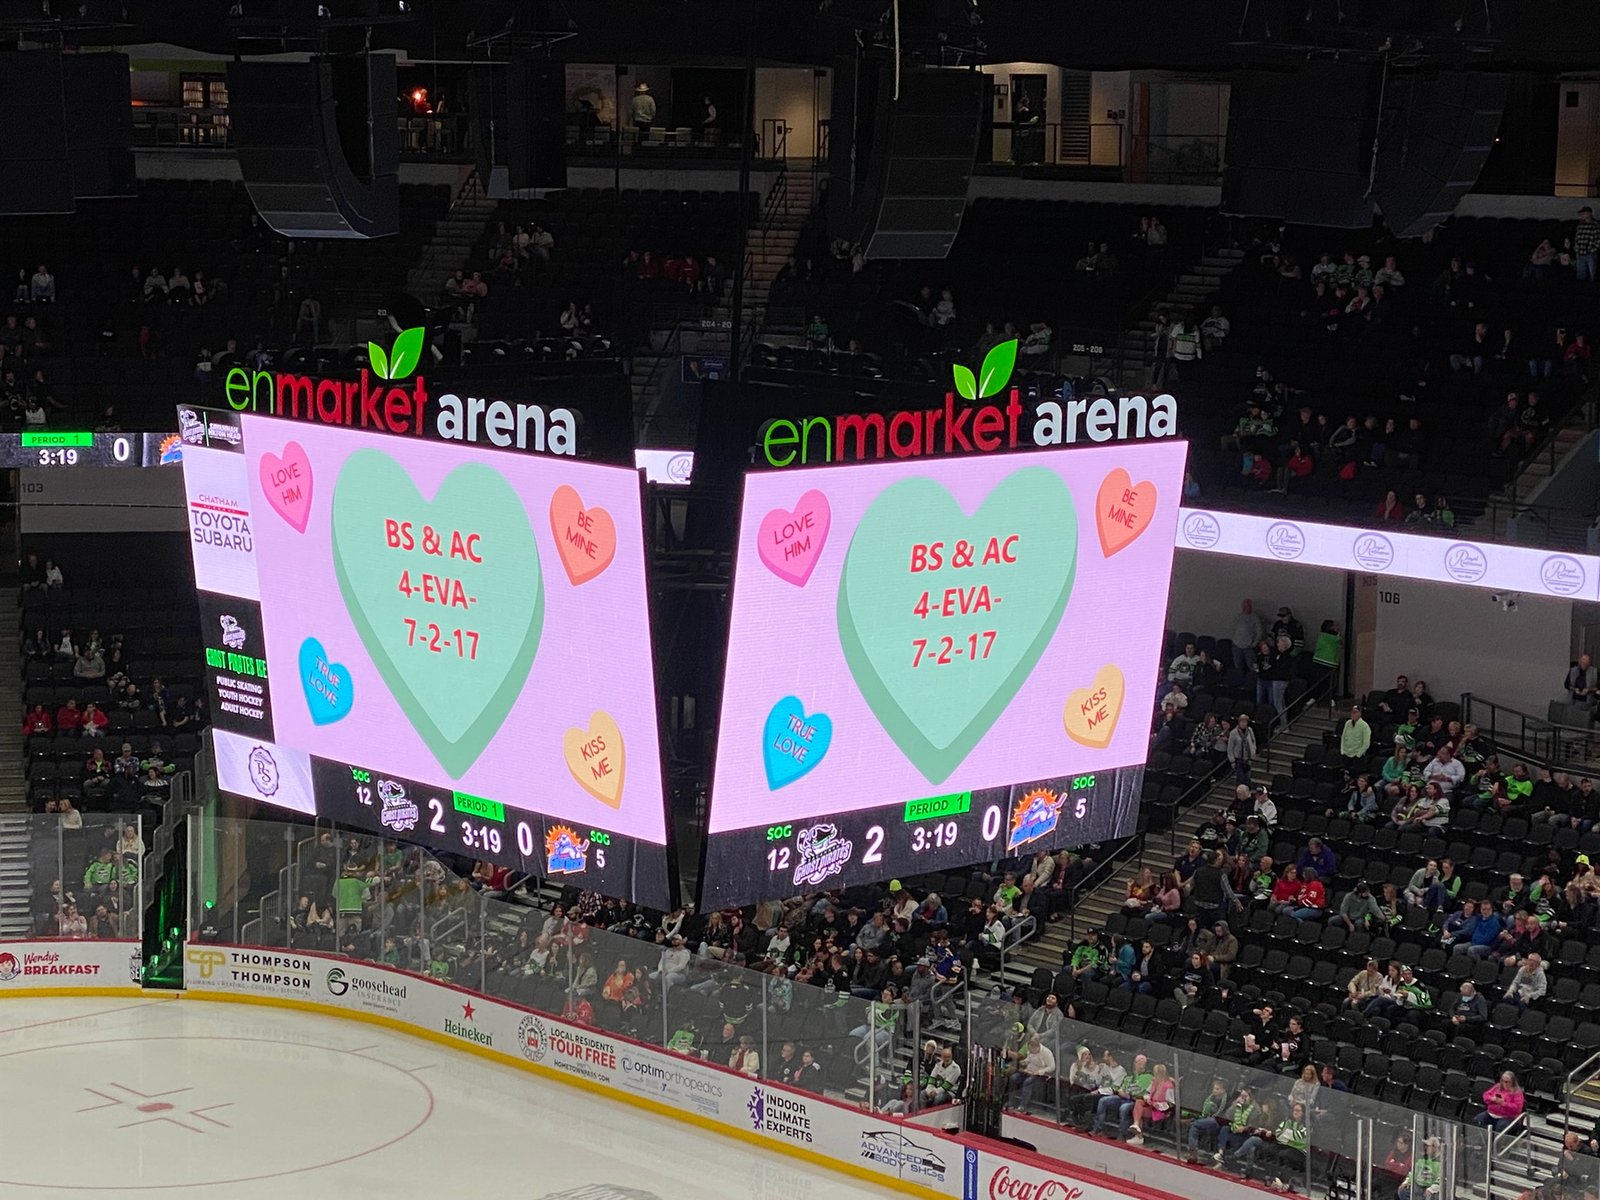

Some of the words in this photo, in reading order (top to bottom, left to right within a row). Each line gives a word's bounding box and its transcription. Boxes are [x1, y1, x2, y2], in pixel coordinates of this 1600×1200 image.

[225, 367, 428, 436] enmarket
[436, 393, 577, 456] arena
[763, 385, 1023, 467] enmarket
[1032, 393, 1179, 447] arena
[32, 436, 66, 444] PERIOD
[74, 435, 80, 444] 1
[113, 438, 130, 461] 0
[38, 449, 78, 465] 3:19
[271, 462, 301, 487] LOVE
[22, 483, 44, 493] 103
[281, 485, 302, 505] HIM
[1121, 488, 1138, 506] BE
[199, 494, 239, 509] CHATHAM
[191, 509, 251, 535] TOYOTA
[577, 511, 594, 533] BE
[773, 512, 815, 545] LOVE
[1107, 505, 1138, 529] MINE
[193, 527, 253, 553] SUBARU
[385, 519, 415, 551] BS
[422, 525, 443, 556] &
[450, 531, 482, 563] AC
[566, 526, 598, 559] MINE
[784, 536, 812, 562] HIM
[910, 541, 944, 573] BS
[951, 540, 974, 568] &
[982, 534, 1020, 566] AC
[398, 570, 477, 610] 4-EVA-
[1379, 591, 1400, 604] 106
[913, 585, 1003, 620] 4-EVA-
[404, 618, 479, 660] 7-2-17
[911, 631, 997, 668] 7-2-17
[216, 675, 236, 688] PUBLIC
[236, 681, 263, 694] SKATING
[316, 655, 341, 691] TRUE
[218, 688, 238, 701] YOUTH
[238, 694, 263, 707] HOCKEY
[308, 671, 338, 708] LOVE
[1080, 686, 1107, 716] KISS
[220, 701, 239, 714] ADULT
[239, 706, 264, 720] HOCKEY
[1087, 704, 1110, 730] ME
[787, 713, 818, 743] TRUE
[580, 735, 606, 761] KISS
[773, 733, 810, 764] LOVE
[352, 769, 370, 783] SOG
[590, 757, 613, 781] ME
[1073, 775, 1095, 790] SOG
[356, 786, 373, 806] 12
[457, 796, 488, 813] PERIOD
[491, 803, 499, 817] 1
[909, 800, 949, 816] PERIOD
[956, 794, 964, 811] 1
[428, 798, 446, 833] 2
[1075, 798, 1086, 819] 5
[767, 824, 792, 841] SOG
[982, 805, 1001, 842] 0
[461, 821, 501, 853] 3:19
[517, 821, 533, 856] 0
[590, 830, 611, 846] SOG
[862, 825, 885, 864] 2
[912, 821, 958, 852] 3:19
[596, 848, 606, 868] 5
[767, 846, 790, 871] 12
[24, 951, 60, 965] Wendy's
[24, 965, 100, 975] BREAKFAST
[231, 953, 311, 971] THOMPSON
[231, 971, 311, 989] THOMPSON
[352, 977, 407, 999] goosehead
[444, 1018, 493, 1046] Heineken
[550, 1027, 574, 1042] LOCAL
[574, 1035, 615, 1054] RESIDENTS
[549, 1036, 583, 1060] TOUR
[585, 1047, 617, 1071] FREE
[766, 1094, 806, 1116] INDOOR
[766, 1107, 811, 1130] CLIMATE
[766, 1120, 813, 1143] EXPERTS
[861, 1141, 924, 1166] ADVANCED
[873, 1151, 906, 1169] BODY
